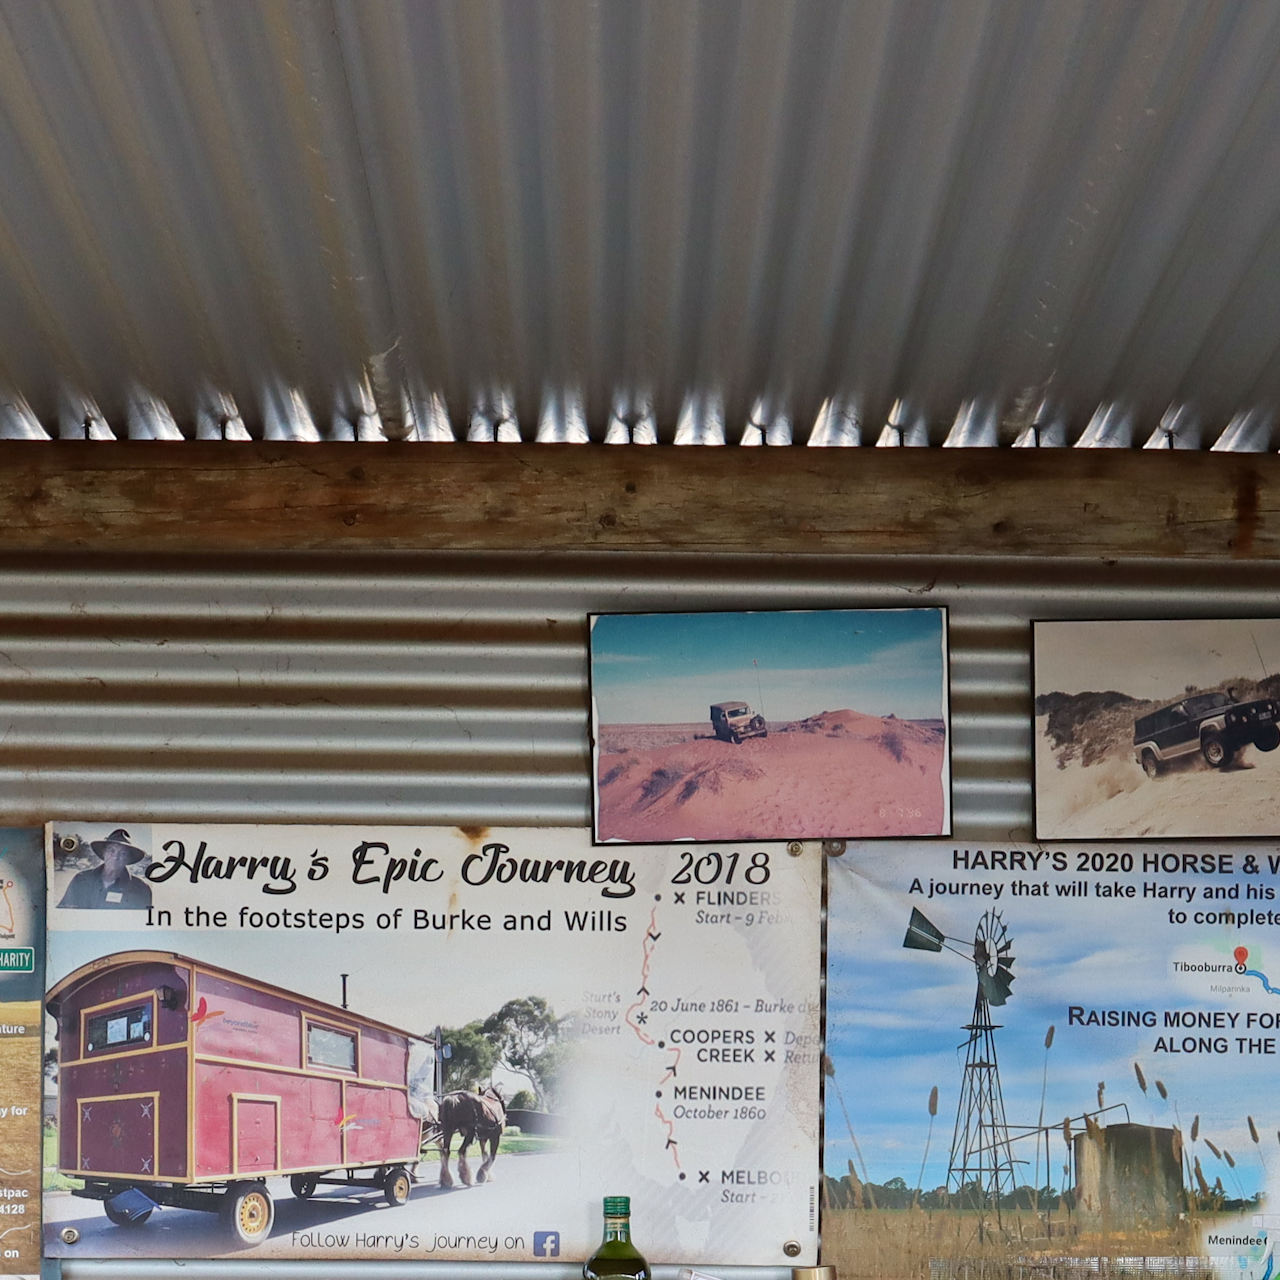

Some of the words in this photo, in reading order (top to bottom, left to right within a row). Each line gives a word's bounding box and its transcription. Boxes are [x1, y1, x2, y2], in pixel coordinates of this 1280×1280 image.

[145, 840, 330, 895] Harry's
[352, 841, 444, 894] Epic
[461, 843, 636, 899] Journey
[671, 851, 771, 886] 2018
[952, 850, 1068, 871] HARRY'S
[1076, 852, 1134, 872] 2020
[1142, 853, 1234, 874] HORSE
[1242, 855, 1260, 875] &
[908, 878, 924, 895] A
[928, 880, 1004, 900] journey
[1010, 880, 1050, 898] that
[1055, 880, 1088, 898] will
[1094, 881, 1136, 898] take
[1142, 882, 1196, 903] Harry
[1203, 883, 1239, 900] and
[1246, 884, 1276, 901] his
[145, 906, 172, 927] In
[184, 906, 227, 928] the
[239, 906, 365, 934] footsteps
[376, 908, 404, 930] of
[414, 910, 492, 930] Burke
[503, 910, 552, 932] and
[564, 910, 628, 932] Wills
[1168, 910, 1188, 926] to
[1173, 962, 1233, 974] Tibooburra
[650, 1001, 668, 1012] 20
[671, 1000, 706, 1013] June
[710, 1000, 740, 1013] 1861
[754, 1000, 794, 1013] Burke
[1068, 1006, 1158, 1028] RAISING
[1164, 1011, 1240, 1030] MONEY
[670, 1029, 755, 1044] COOPERS
[1153, 1036, 1230, 1054] ALONG
[1235, 1038, 1276, 1054] THE
[697, 1049, 755, 1062] CREEK
[674, 1086, 766, 1100] MENINDEE
[11, 1106, 28, 1116] for
[673, 1104, 730, 1120] October
[734, 1106, 766, 1120] 1860
[292, 1231, 350, 1249] Follow
[356, 1232, 420, 1252] Harry's
[425, 1234, 498, 1253] journey
[504, 1236, 525, 1250] on
[1208, 1234, 1262, 1246] Menindee
[4, 1250, 20, 1258] on
